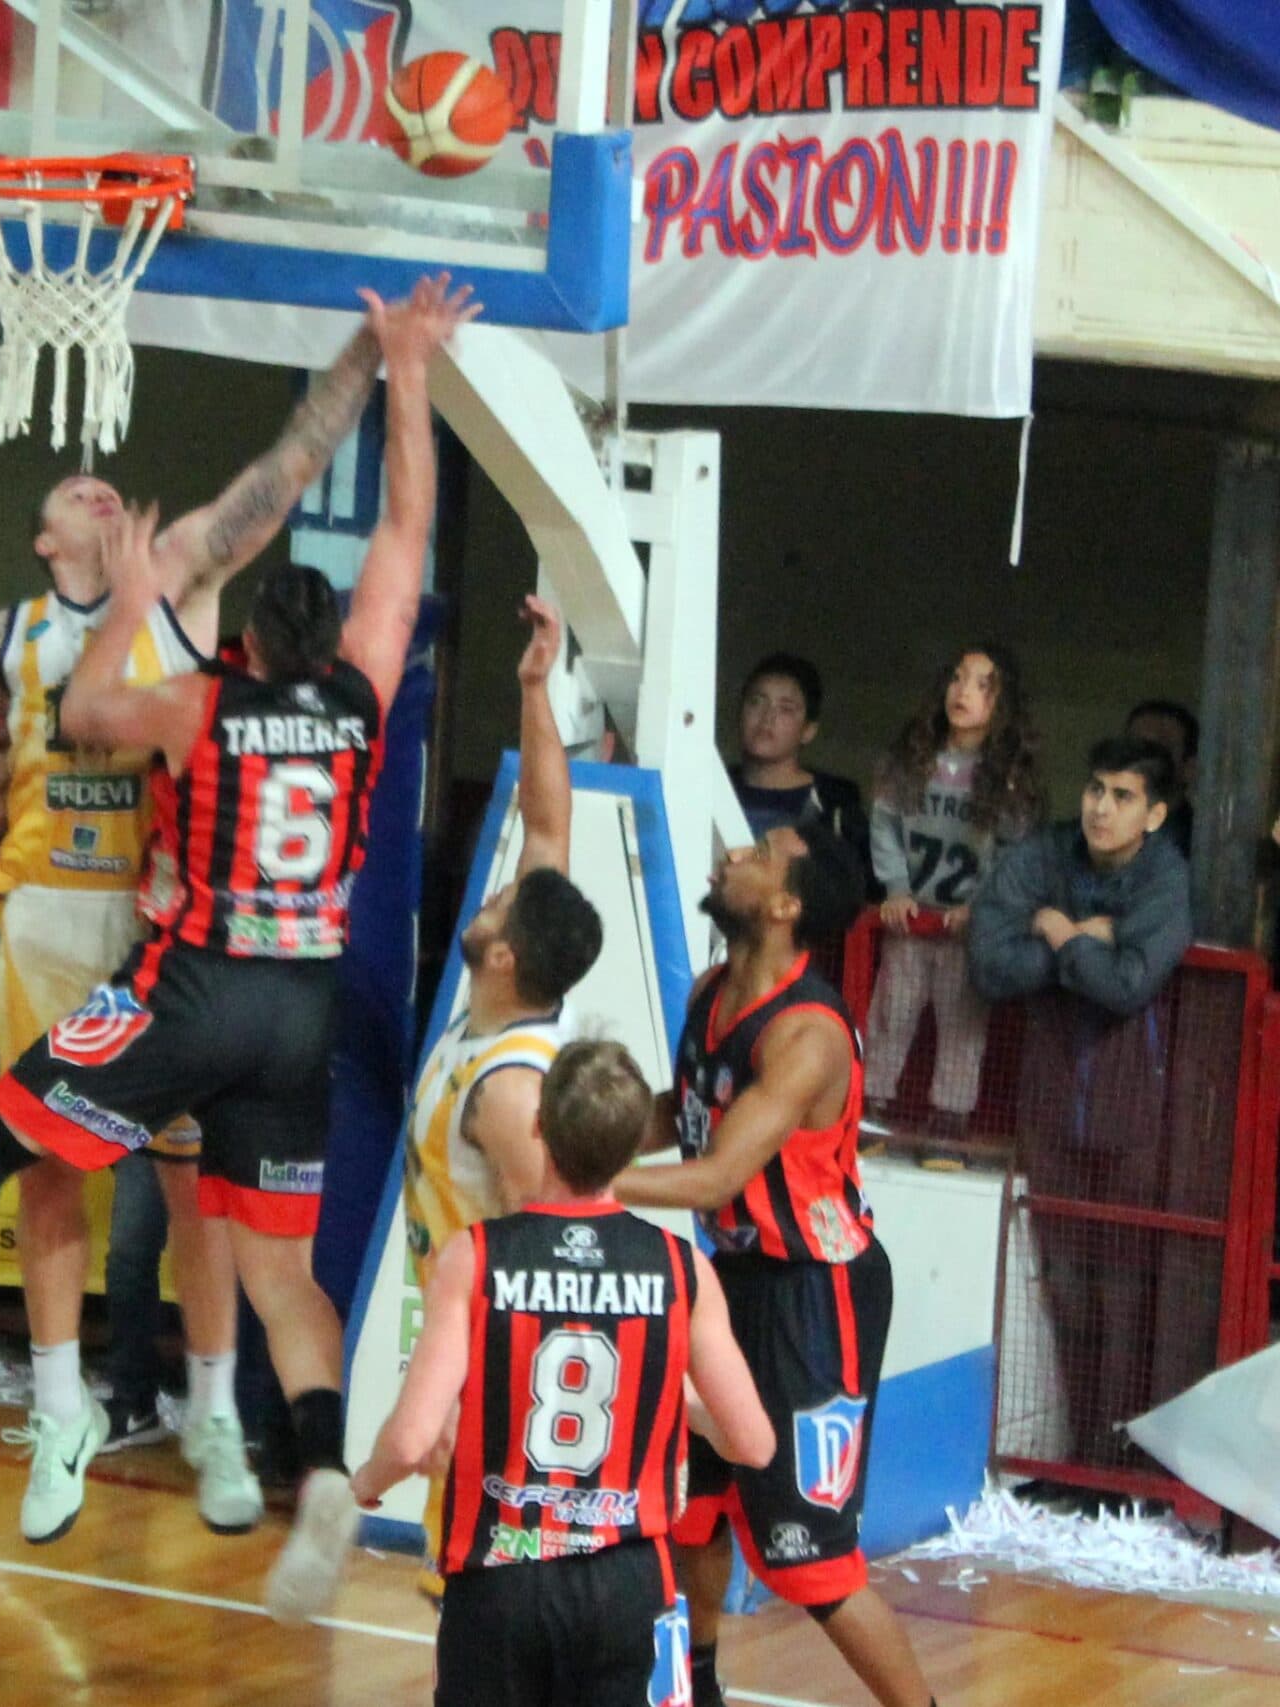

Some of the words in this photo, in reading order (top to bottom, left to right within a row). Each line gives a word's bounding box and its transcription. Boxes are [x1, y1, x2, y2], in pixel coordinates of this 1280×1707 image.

[490, 26, 664, 132] QUN
[669, 4, 1040, 121] COMPRENDE
[642, 128, 1018, 263] PASION!!!
[256, 761, 338, 884] 6
[909, 830, 979, 906] 72
[492, 1269, 665, 1316] MARIANI
[523, 1329, 620, 1478] 8
